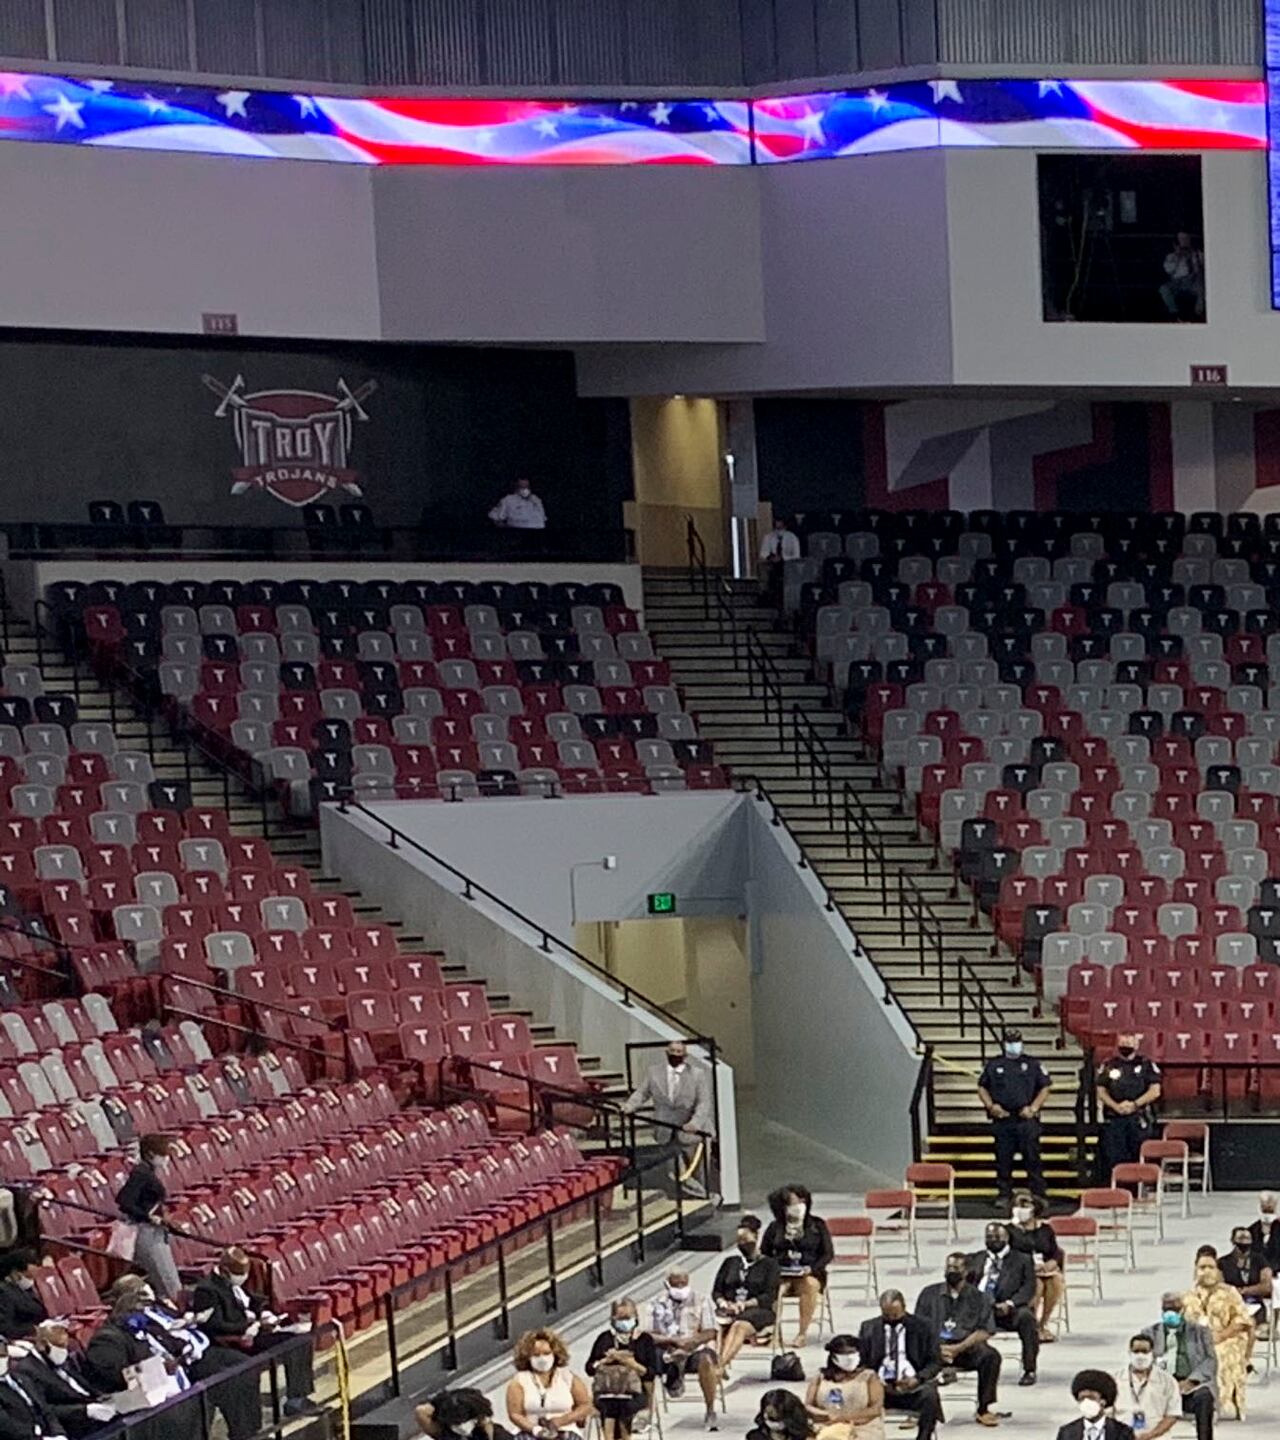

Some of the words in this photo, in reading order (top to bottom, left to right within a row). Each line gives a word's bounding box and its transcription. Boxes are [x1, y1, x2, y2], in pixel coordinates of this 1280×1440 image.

[1198, 369, 1221, 382] 116
[252, 420, 335, 466] TROY
[255, 468, 337, 489] TROJANS
